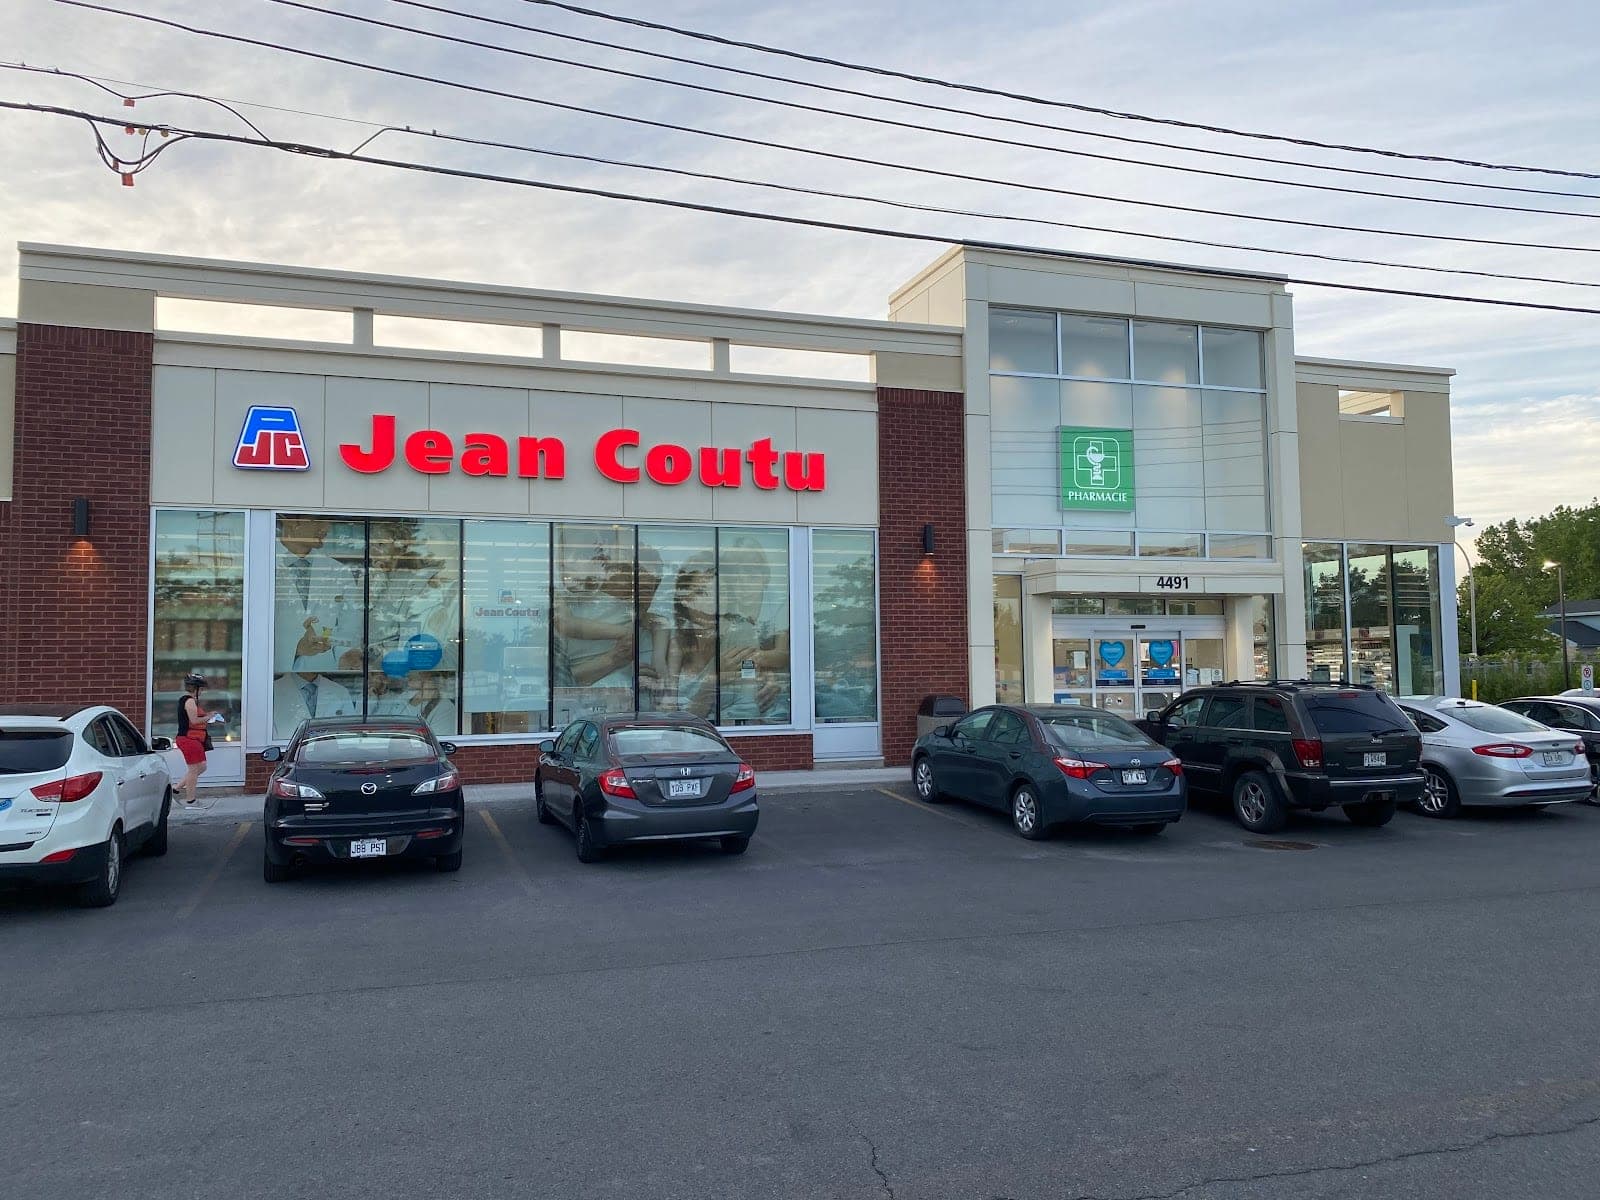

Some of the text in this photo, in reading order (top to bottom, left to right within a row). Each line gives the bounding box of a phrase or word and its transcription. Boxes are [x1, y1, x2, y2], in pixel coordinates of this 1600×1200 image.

[339, 414, 826, 492] Jean Coutu
[1067, 490, 1128, 503] PHARMACIE
[1156, 575, 1190, 590] 4491
